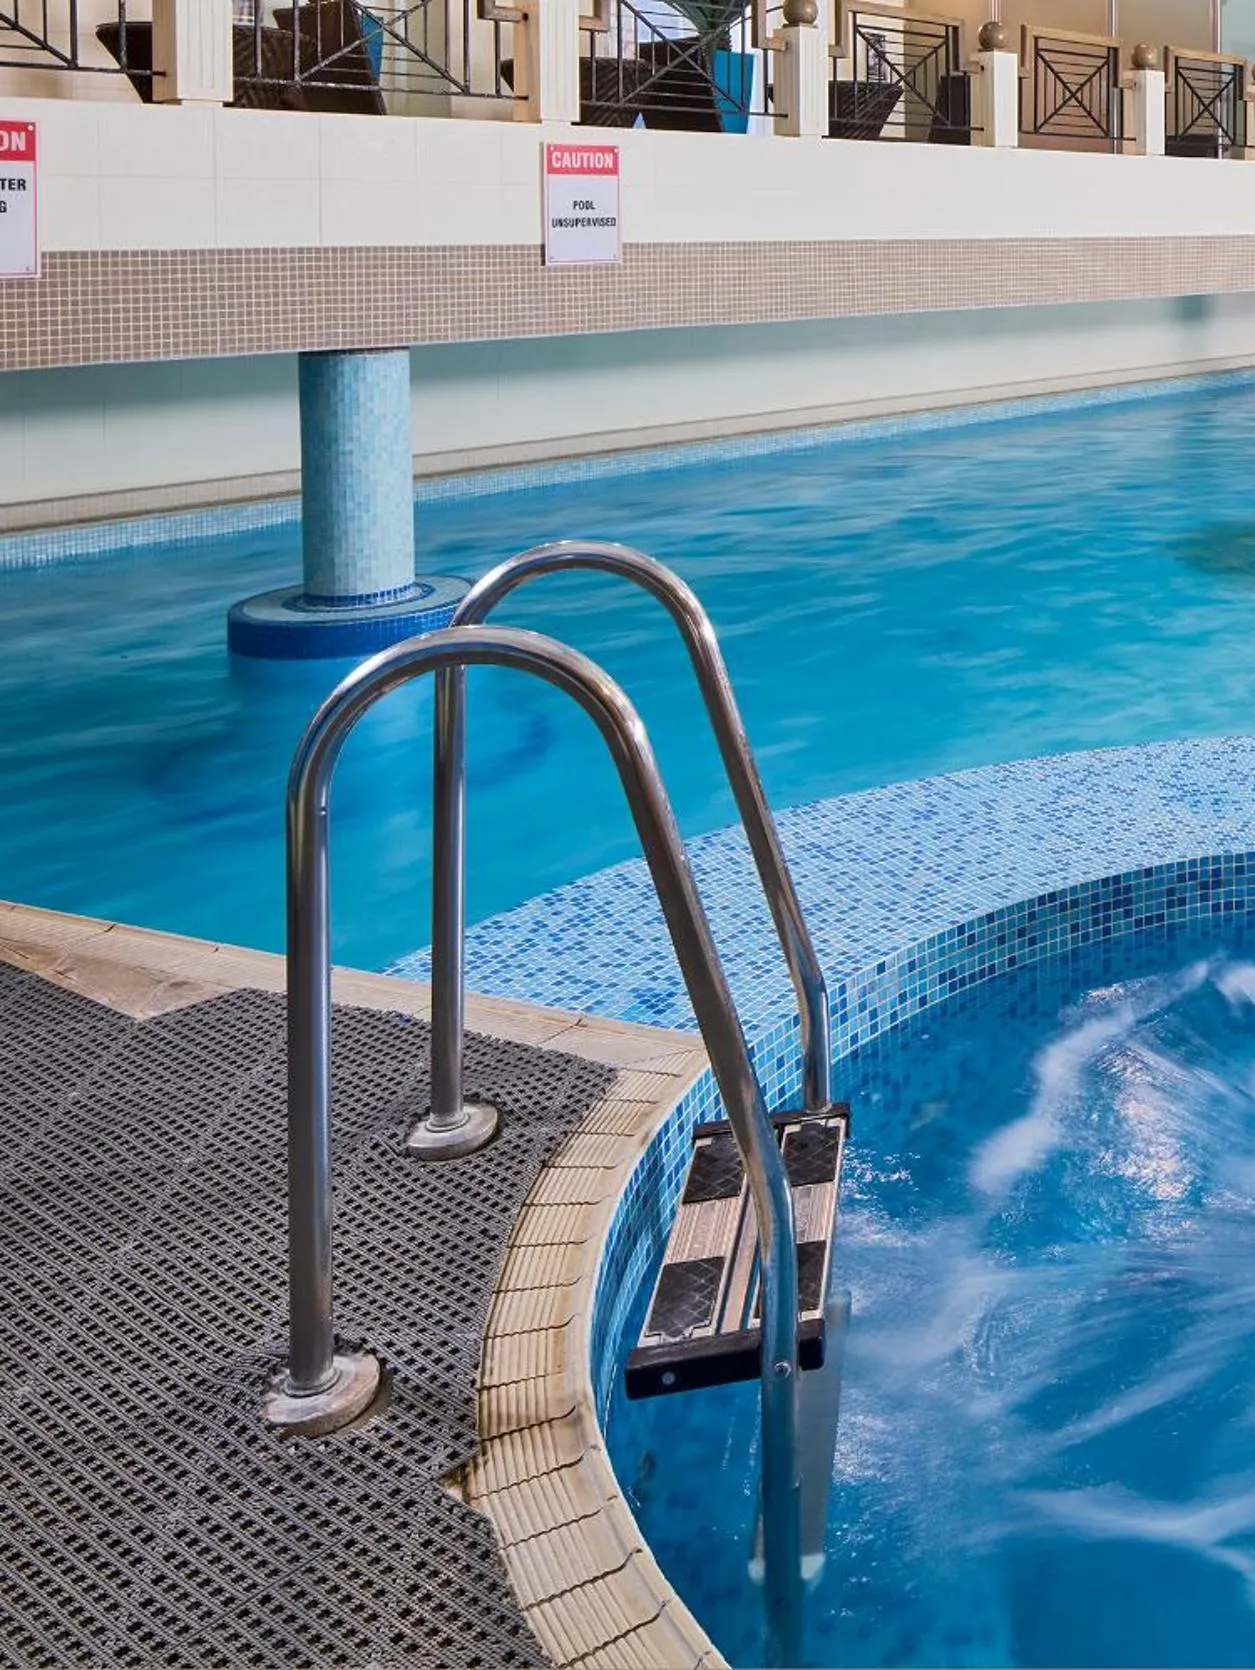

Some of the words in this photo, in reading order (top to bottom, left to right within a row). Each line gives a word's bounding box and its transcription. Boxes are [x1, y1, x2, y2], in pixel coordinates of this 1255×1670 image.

[551, 151, 614, 169] CAUTION
[0, 178, 26, 191] TER
[573, 200, 596, 210] POOL
[551, 217, 617, 228] UNSUPERVISED
